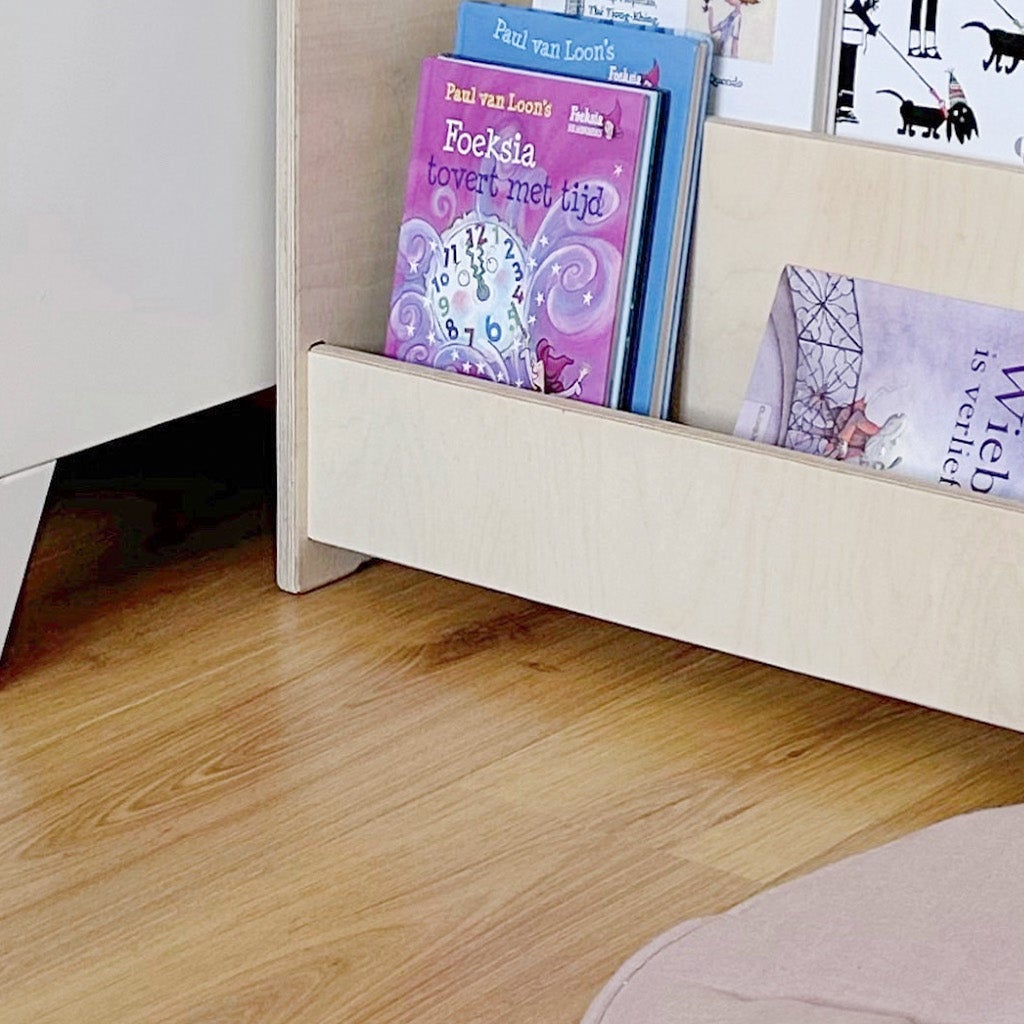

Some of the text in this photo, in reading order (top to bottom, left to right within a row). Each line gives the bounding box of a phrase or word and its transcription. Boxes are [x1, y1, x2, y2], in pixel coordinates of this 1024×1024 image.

[493, 18, 615, 62] Paul van Loon's
[445, 82, 552, 118] Paul van Loon's
[443, 119, 537, 169] Foeksia
[427, 154, 604, 221] tovert met tijd
[443, 244, 458, 269] 11
[504, 238, 515, 260] 2
[432, 272, 450, 293] 10
[512, 262, 524, 282] 3
[512, 284, 524, 305] 4
[438, 296, 450, 318] 9
[446, 318, 459, 341] 8
[464, 327, 474, 347] 7
[485, 315, 501, 343] 6
[971, 348, 998, 373] is
